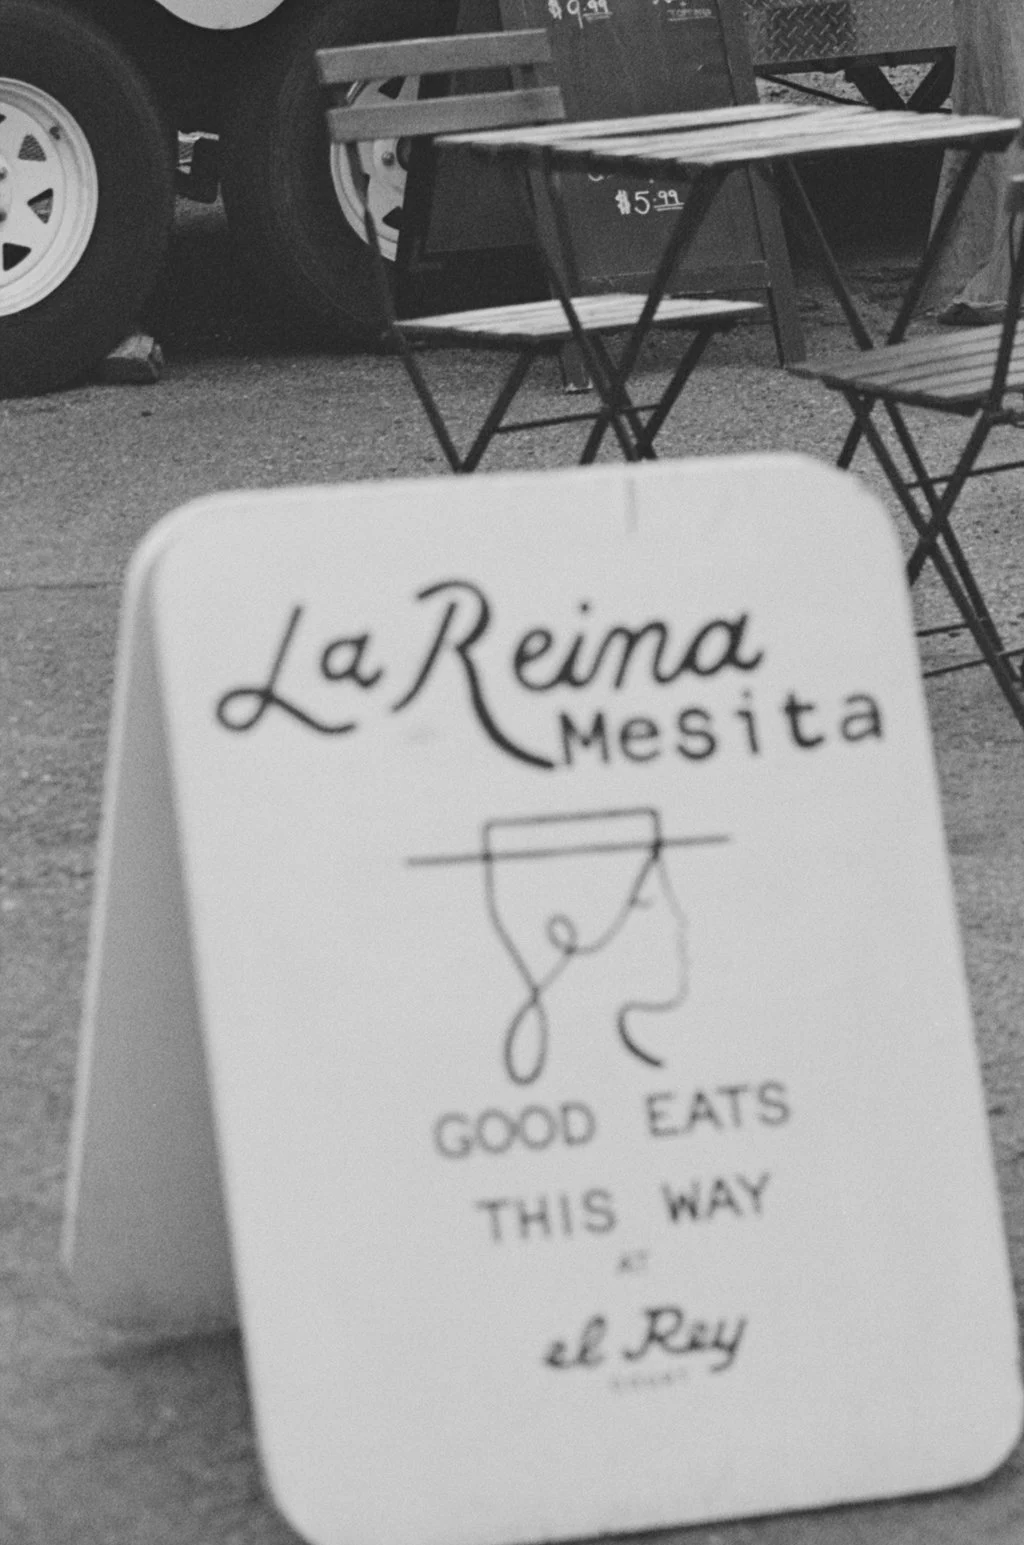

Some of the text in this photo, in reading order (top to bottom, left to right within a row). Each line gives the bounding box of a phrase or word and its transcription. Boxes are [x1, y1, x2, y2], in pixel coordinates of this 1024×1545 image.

[615, 189, 681, 215] $5.99
[215, 580, 765, 771] La Reina
[556, 689, 885, 768] Mesita
[432, 1080, 792, 1160] GOOD EATS
[473, 1170, 772, 1243] THIS WAY
[621, 1304, 749, 1374] Rey
